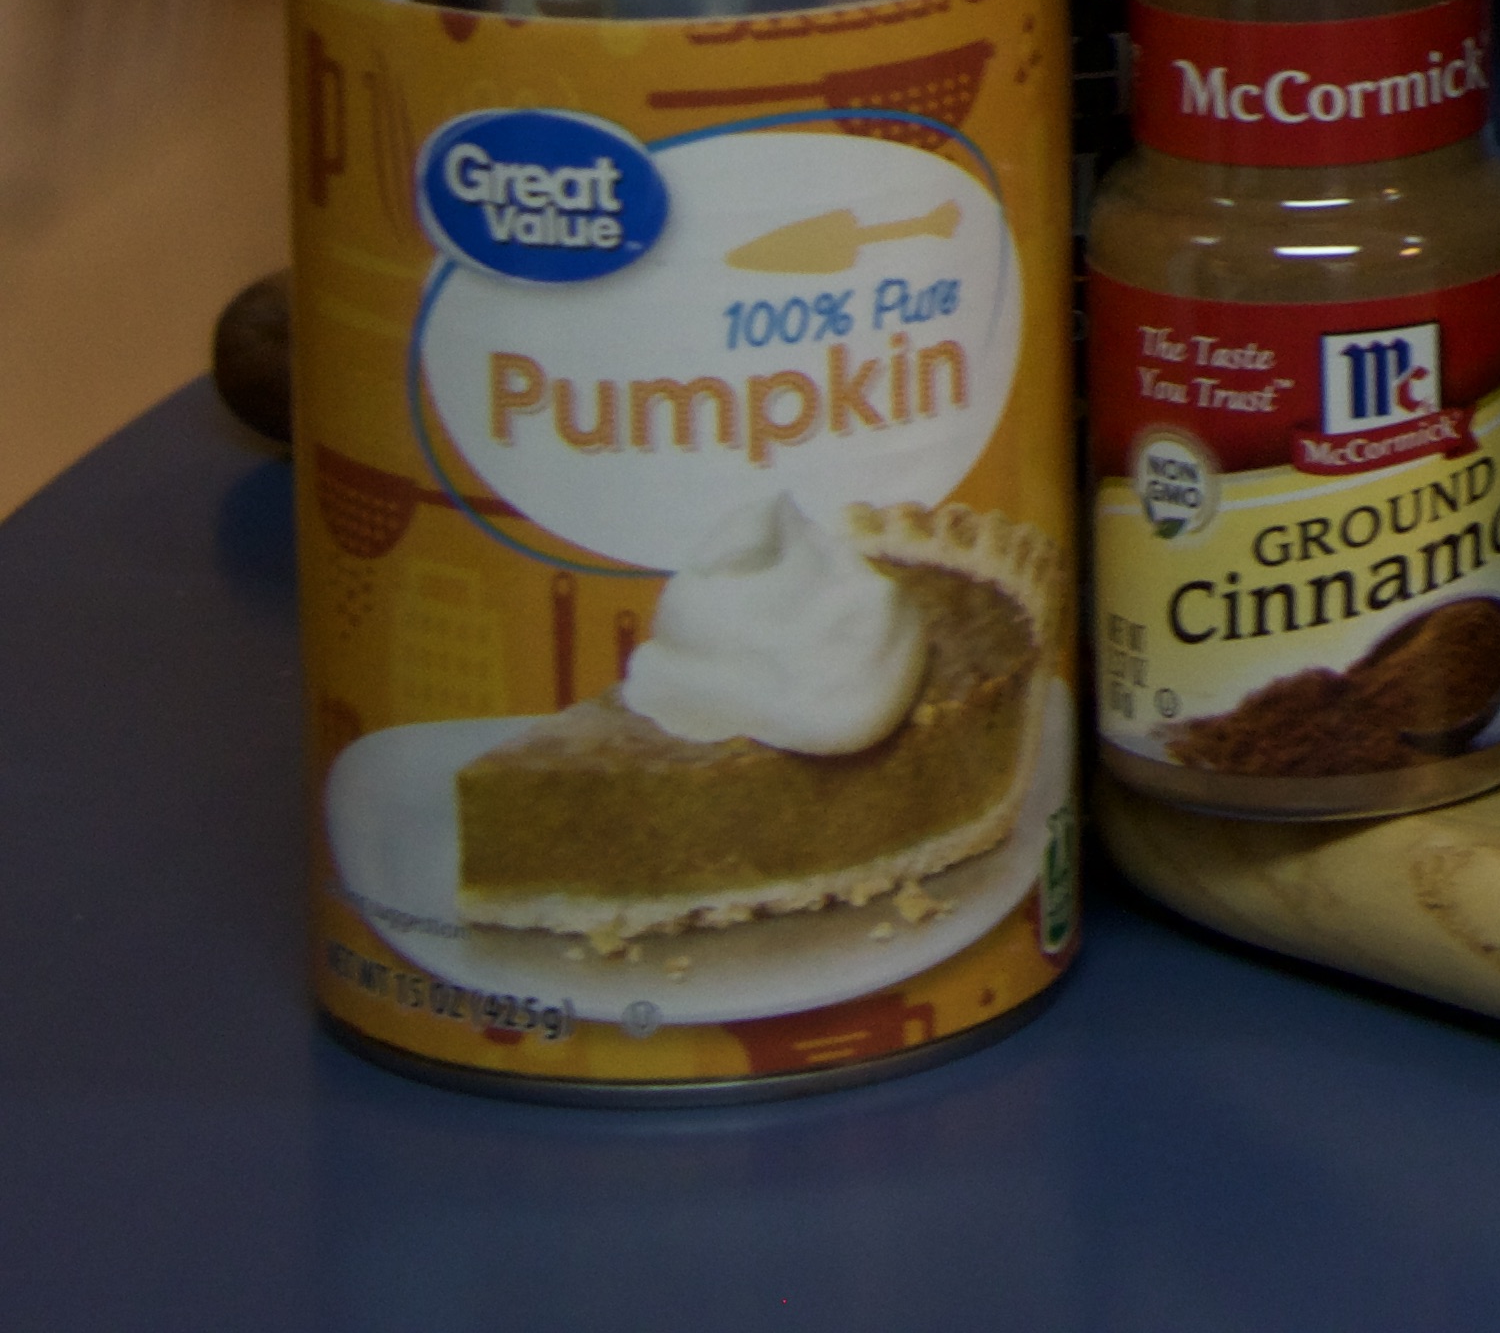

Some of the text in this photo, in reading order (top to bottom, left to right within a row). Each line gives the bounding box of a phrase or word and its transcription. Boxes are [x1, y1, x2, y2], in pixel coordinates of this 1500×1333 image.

[1172, 36, 1490, 124] McCormick
[444, 143, 622, 214] Great
[485, 200, 622, 252] Value
[725, 289, 854, 351] 100%
[1190, 335, 1276, 371] Taste
[487, 333, 972, 467] Pumpkin
[1251, 455, 1497, 569] GROUND
